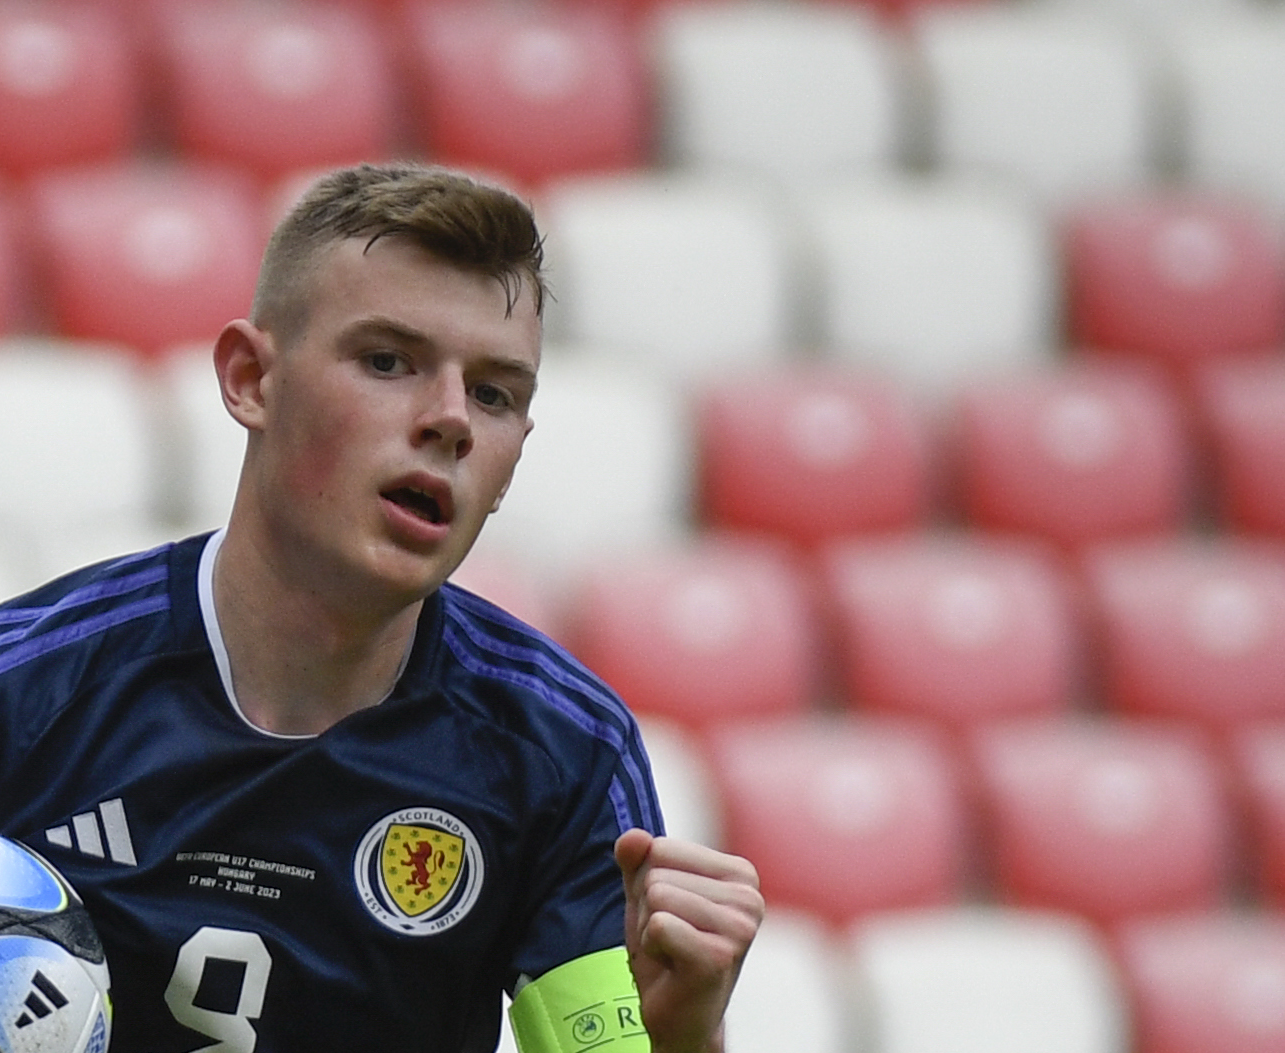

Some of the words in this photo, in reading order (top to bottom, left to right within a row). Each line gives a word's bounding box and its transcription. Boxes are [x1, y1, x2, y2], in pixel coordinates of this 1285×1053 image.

[398, 811, 460, 833] SCOTLAND
[217, 865, 257, 881] HUNGARY
[231, 856, 247, 867] U17
[248, 858, 316, 881] CHAMPIONSHIPS
[188, 874, 199, 885] 17
[199, 876, 217, 888] MAY
[225, 880, 233, 892] 2
[233, 882, 257, 896] JUNE
[256, 886, 282, 900] 2023
[365, 896, 383, 915] EST
[434, 913, 456, 930] 1873
